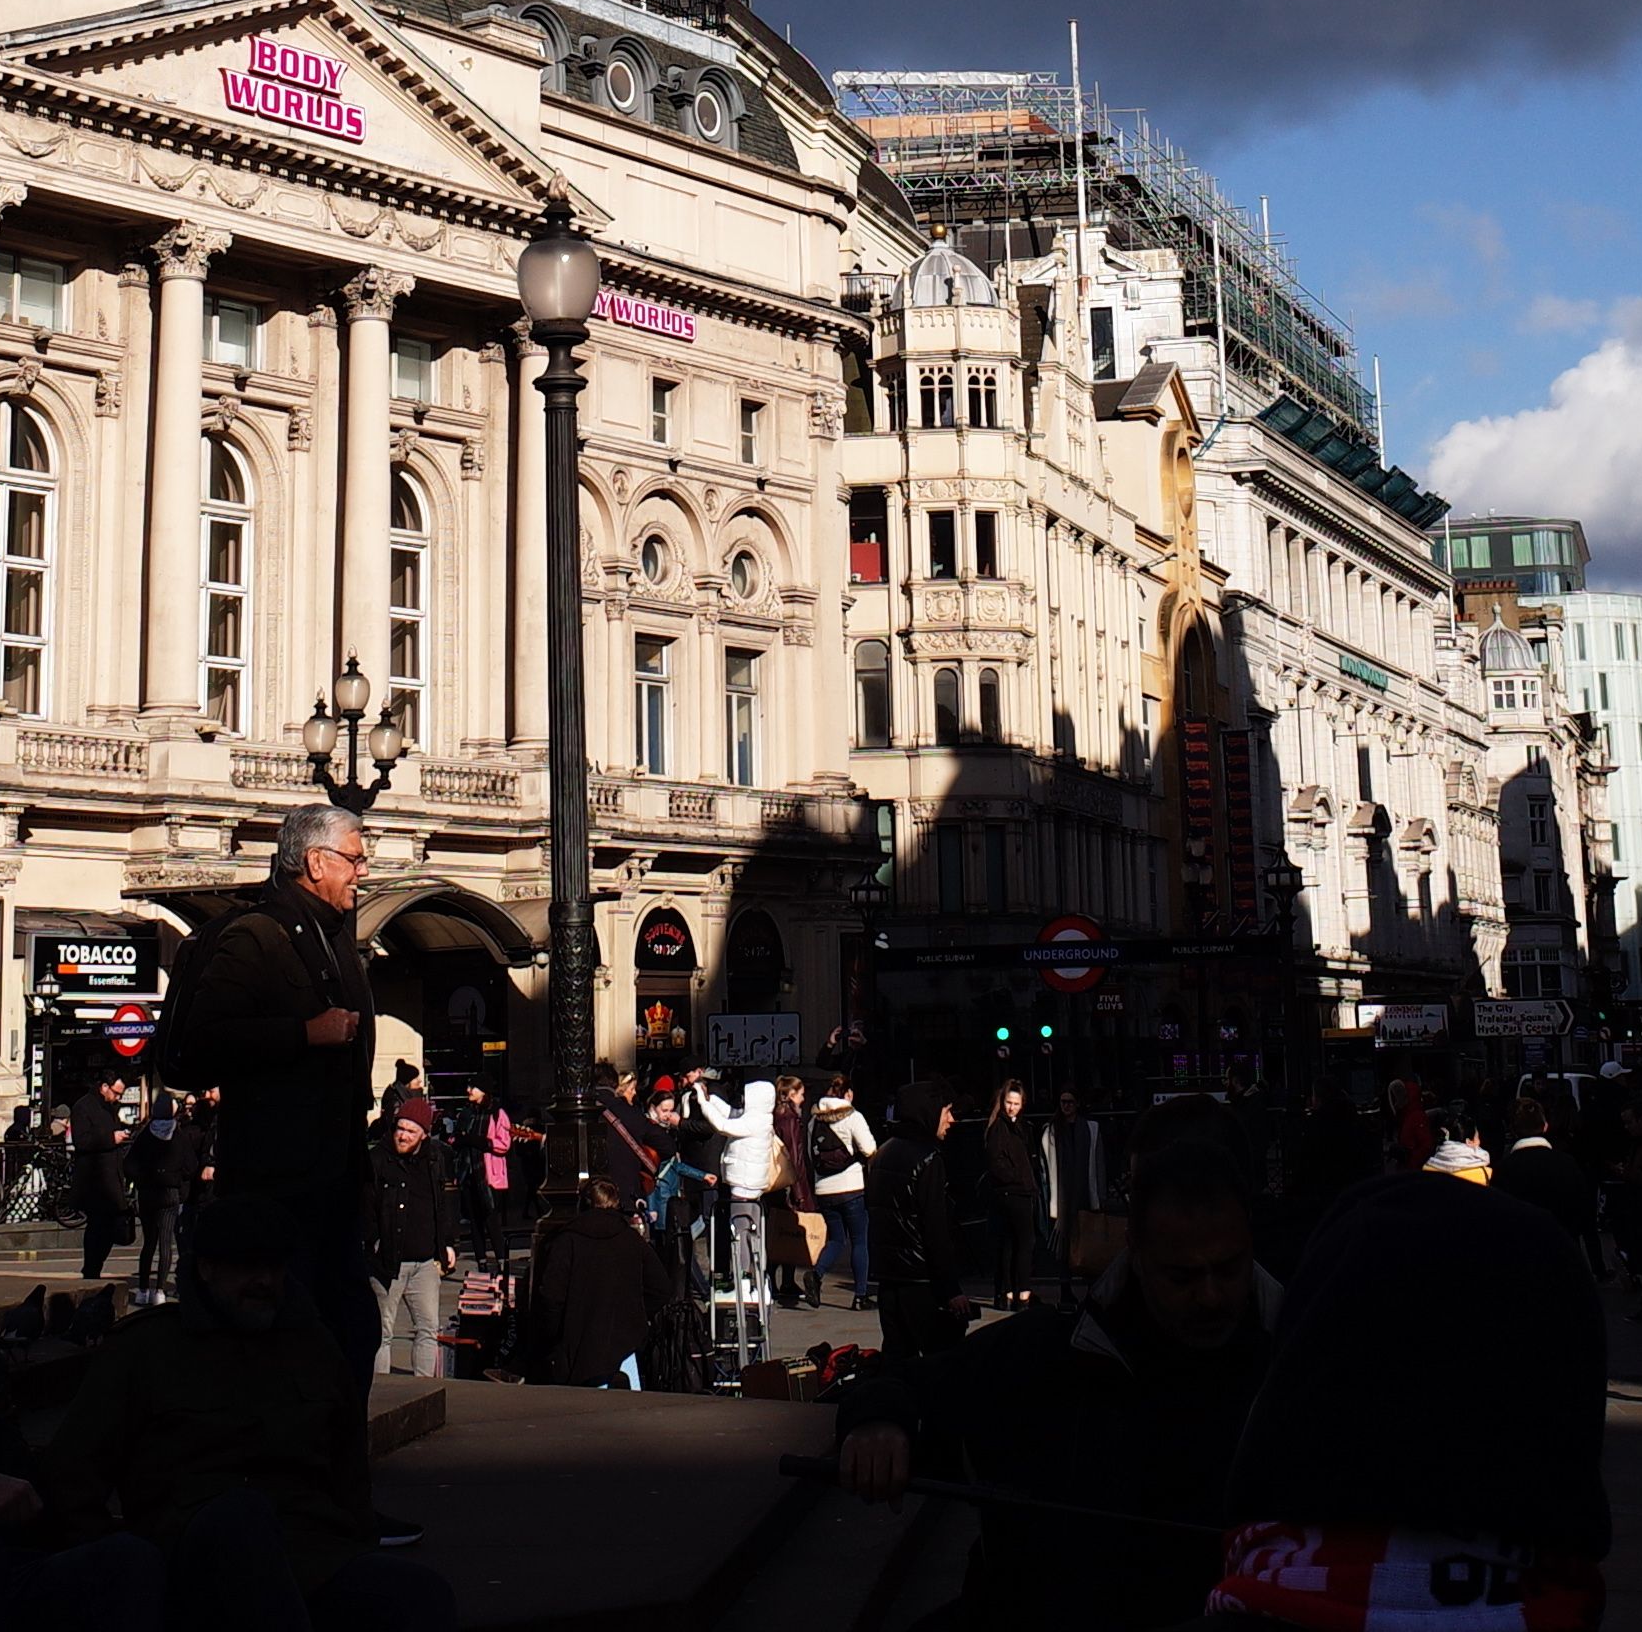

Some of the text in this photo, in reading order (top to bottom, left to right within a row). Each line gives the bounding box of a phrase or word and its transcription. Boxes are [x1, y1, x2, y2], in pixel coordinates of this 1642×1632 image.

[248, 34, 349, 98] BODY
[218, 68, 366, 145] WORLDS
[610, 294, 697, 343] WORLDS
[57, 944, 137, 964] TOBACCO
[1023, 947, 1120, 962] UNDERGROUND
[1099, 994, 1121, 1003] FIVE
[1096, 1002, 1124, 1011] GUYS
[1477, 1004, 1514, 1015] The City
[104, 1024, 156, 1036] UNDERGROUND
